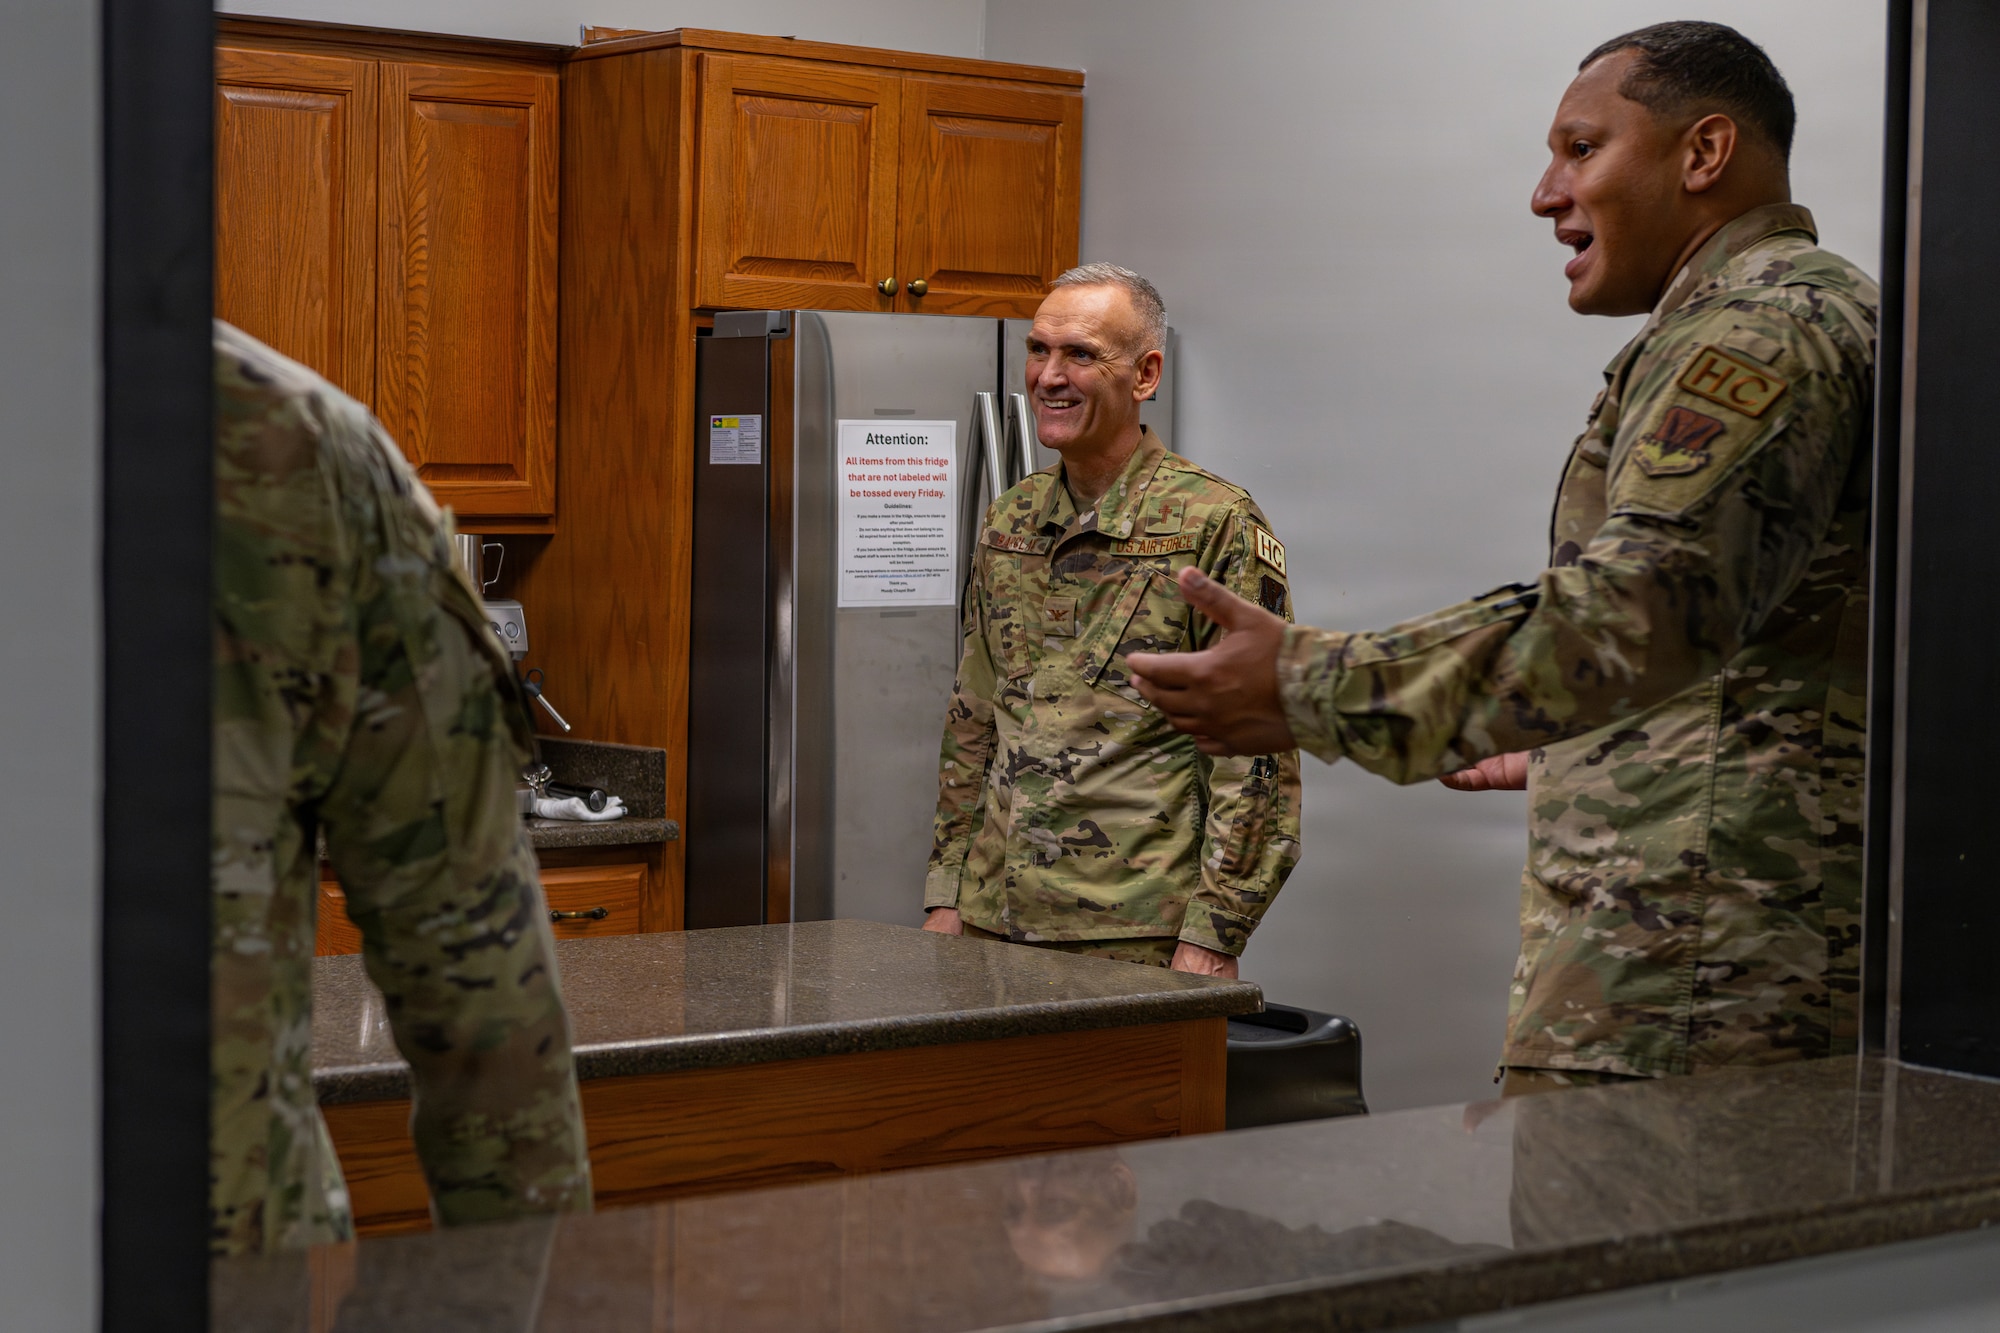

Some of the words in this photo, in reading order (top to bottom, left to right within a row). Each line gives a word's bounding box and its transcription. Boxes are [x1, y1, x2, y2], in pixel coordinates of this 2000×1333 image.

[1691, 356, 1769, 406] HC
[866, 433, 928, 445] Attention:
[925, 457, 949, 467] fridge
[850, 489, 861, 497] be
[863, 489, 891, 497] tossed
[893, 489, 916, 499] every
[918, 489, 945, 499] Friday.
[1138, 540, 1156, 554] AIR
[1160, 534, 1196, 552] FORCE
[1261, 534, 1282, 568] HC
